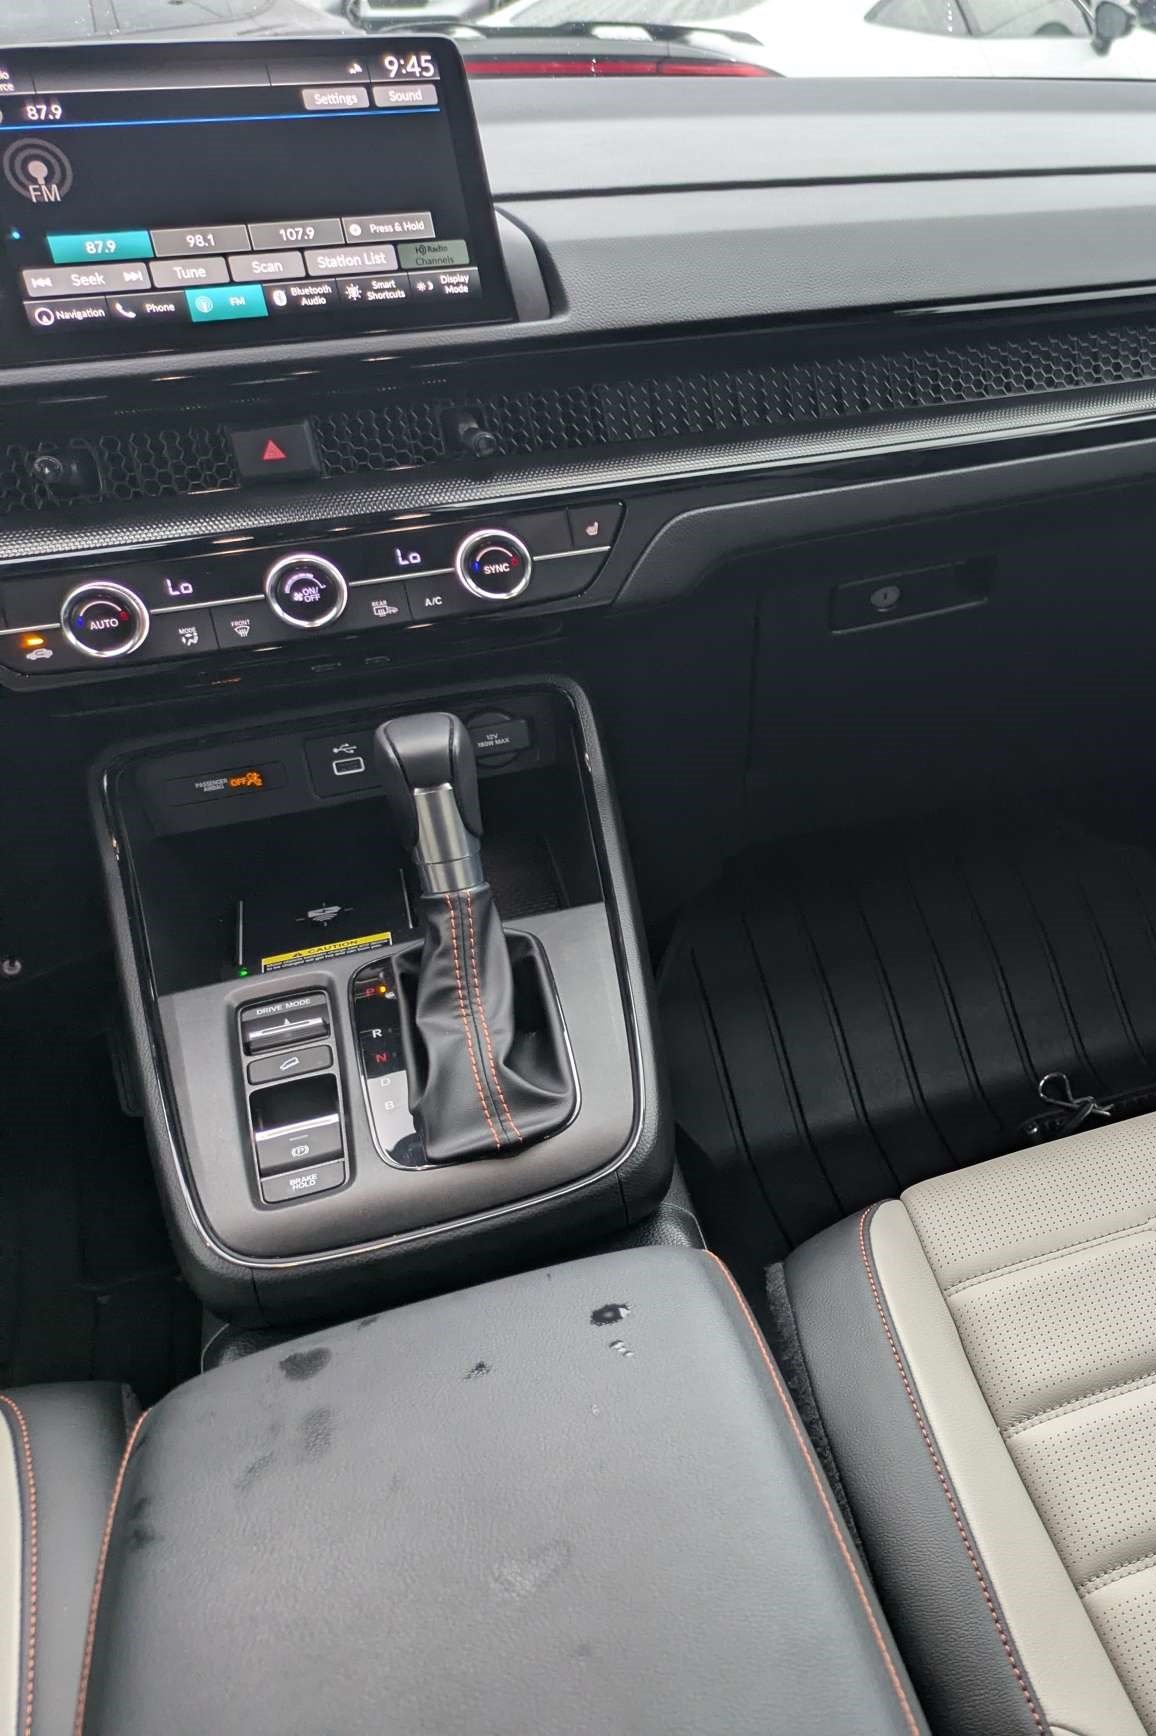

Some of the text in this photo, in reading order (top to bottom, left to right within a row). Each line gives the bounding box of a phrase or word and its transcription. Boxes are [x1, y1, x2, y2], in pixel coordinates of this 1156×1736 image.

[383, 55, 435, 78] 9:45
[314, 91, 359, 106] Settings
[388, 90, 423, 102] Sound
[26, 104, 63, 121] 87.9
[29, 183, 62, 203] FM
[369, 219, 425, 234] Press & Hold
[279, 226, 315, 241] 107.9
[85, 239, 117, 255] 87.9
[185, 233, 216, 248] 98.1
[317, 251, 388, 269] Station List
[415, 255, 454, 266] Channels
[172, 265, 207, 280] Tune
[251, 260, 284, 274] Scan
[70, 272, 106, 287] Seek
[371, 279, 397, 290] Smart
[440, 274, 470, 285] Display
[290, 284, 332, 296] Bluetooth
[366, 290, 406, 301] Shortcuts
[445, 285, 469, 294] Mode
[145, 302, 175, 313] Phone
[301, 296, 327, 306] Audio
[56, 307, 106, 320] Navigation
[482, 562, 511, 575] SYNC
[424, 595, 443, 607] A/C
[89, 618, 120, 631] AUTO
[308, 940, 358, 953] CAUTION
[256, 998, 311, 1016] DRIVE MODE
[372, 1028, 383, 1039] R
[375, 1052, 388, 1063] N
[289, 1173, 318, 1186] BRAKE
[291, 1179, 316, 1191] HOLD
